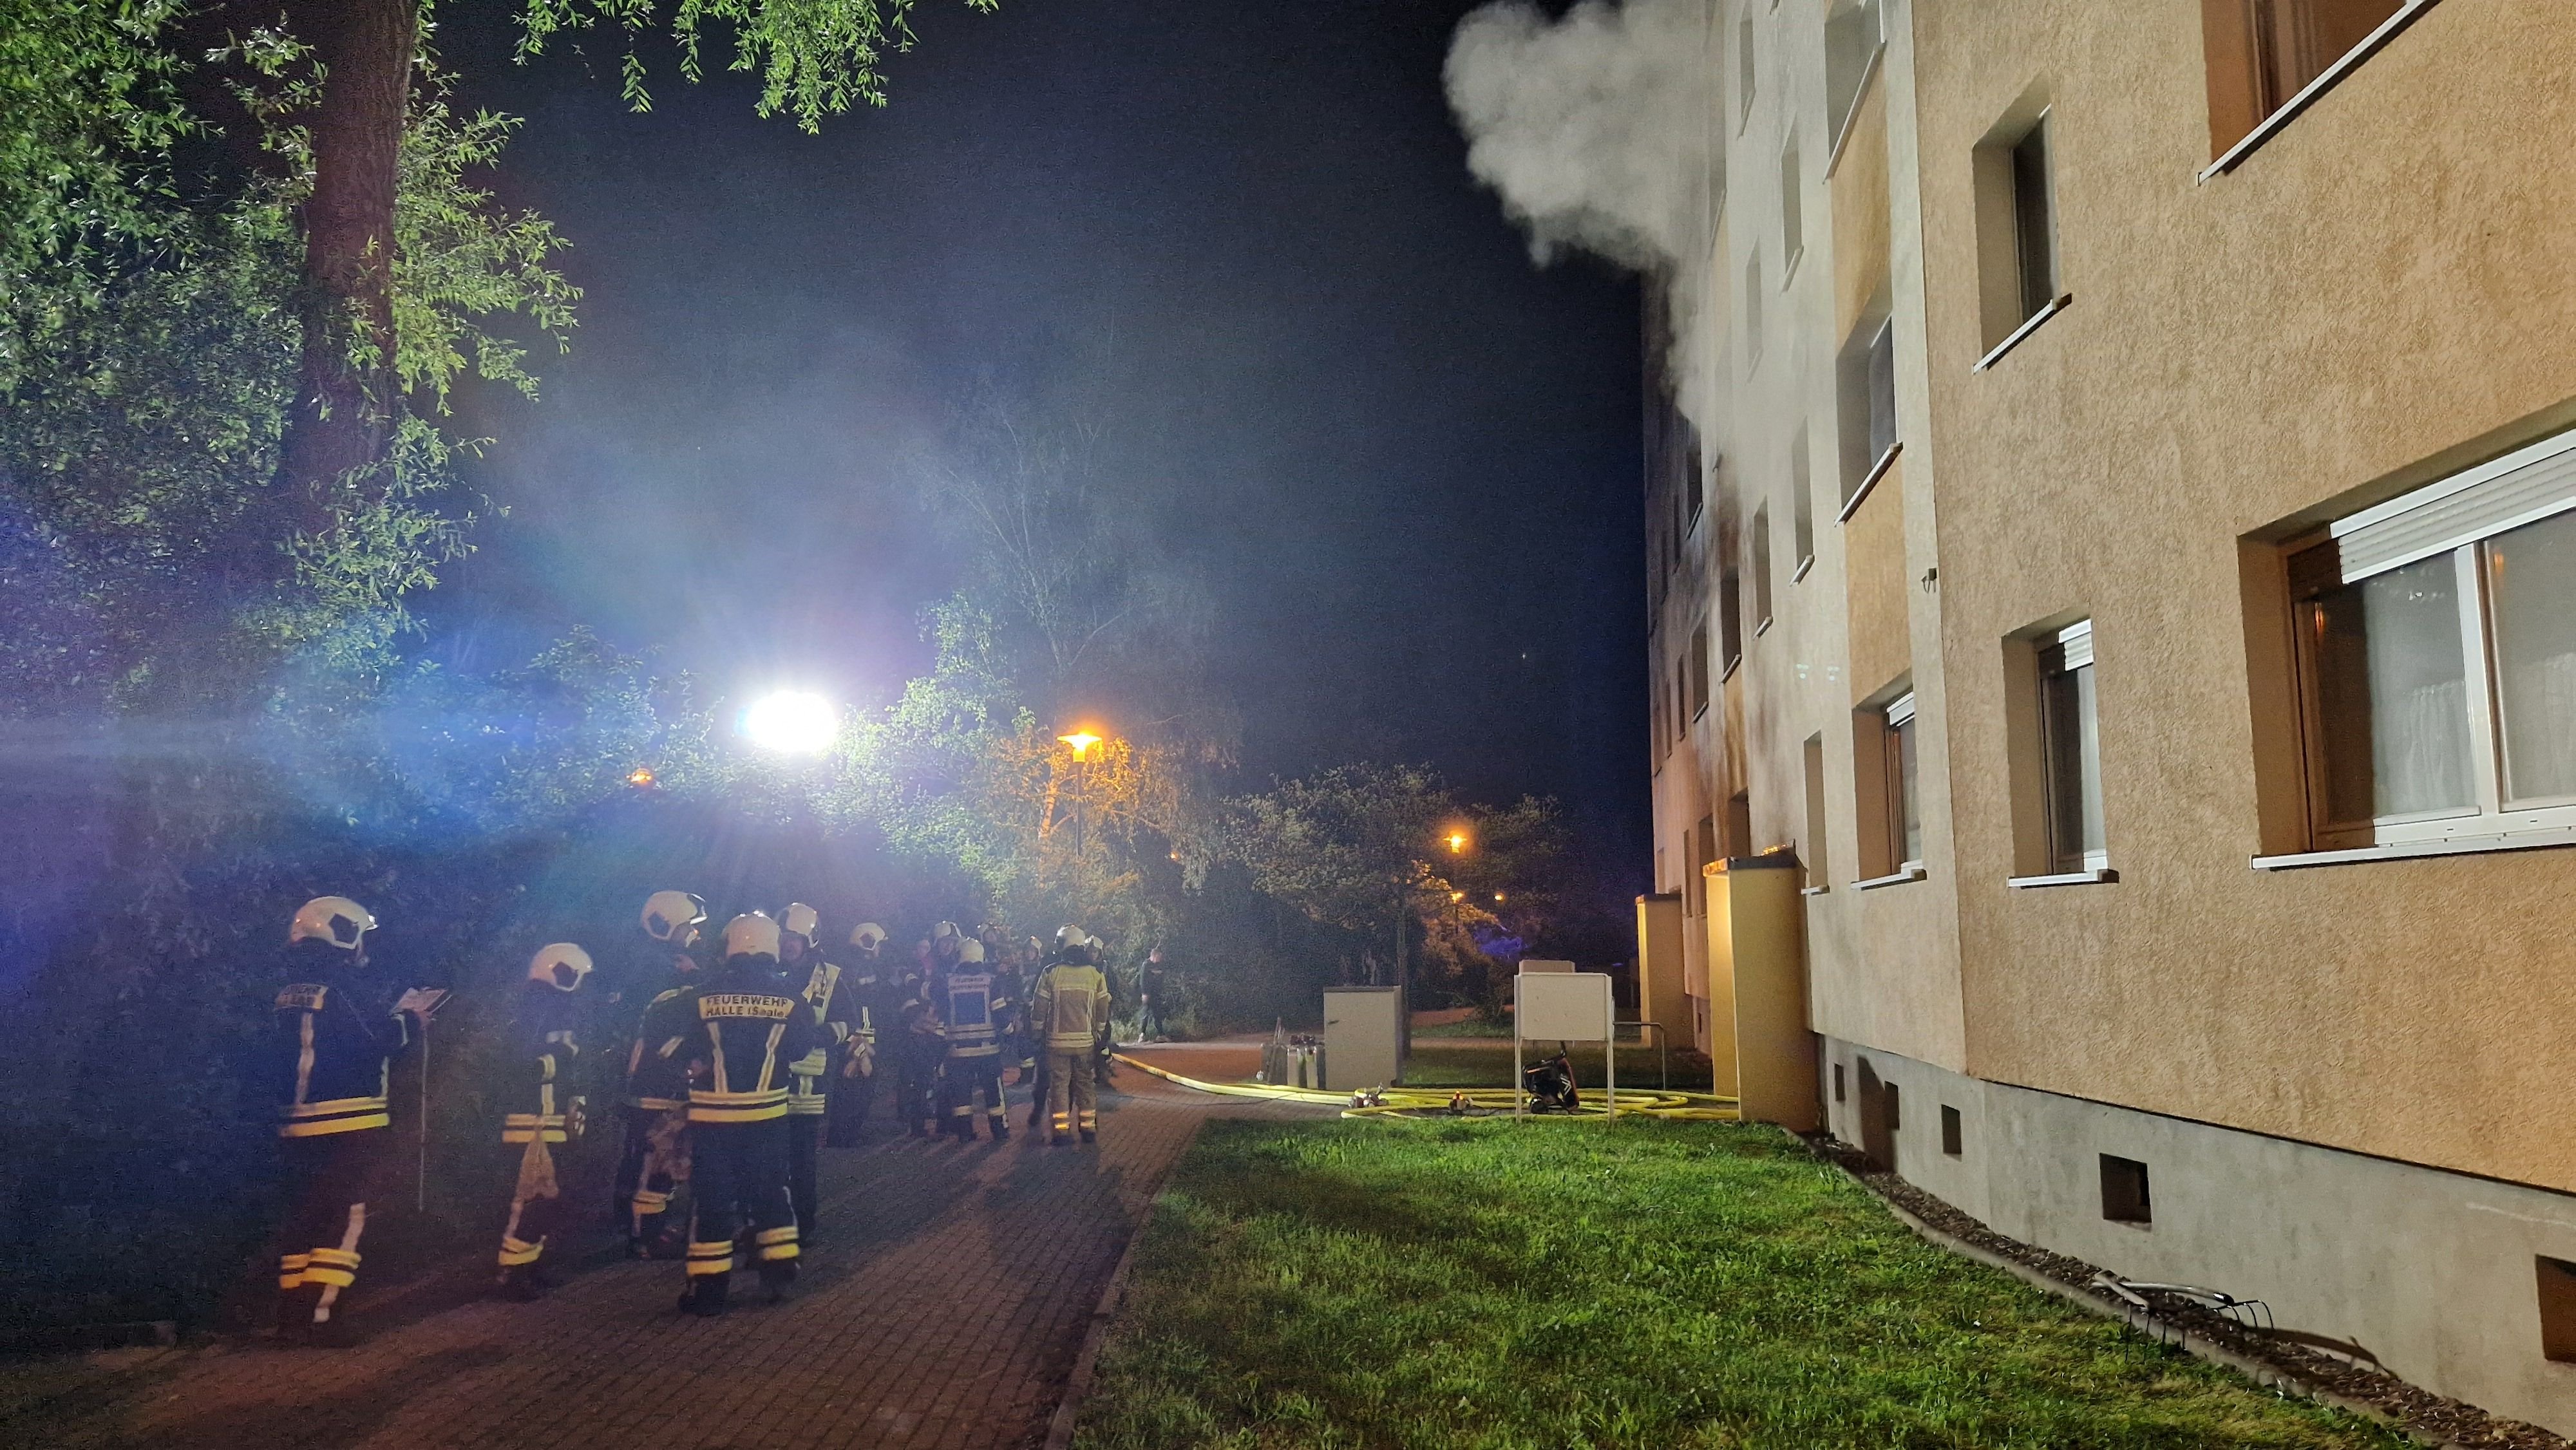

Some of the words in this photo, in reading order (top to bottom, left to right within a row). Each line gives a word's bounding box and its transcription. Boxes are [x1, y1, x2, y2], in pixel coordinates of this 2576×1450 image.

[706, 995, 788, 1007] FEUERWEHR
[706, 1006, 743, 1017] HALLE
[748, 1006, 786, 1017] (Saale
